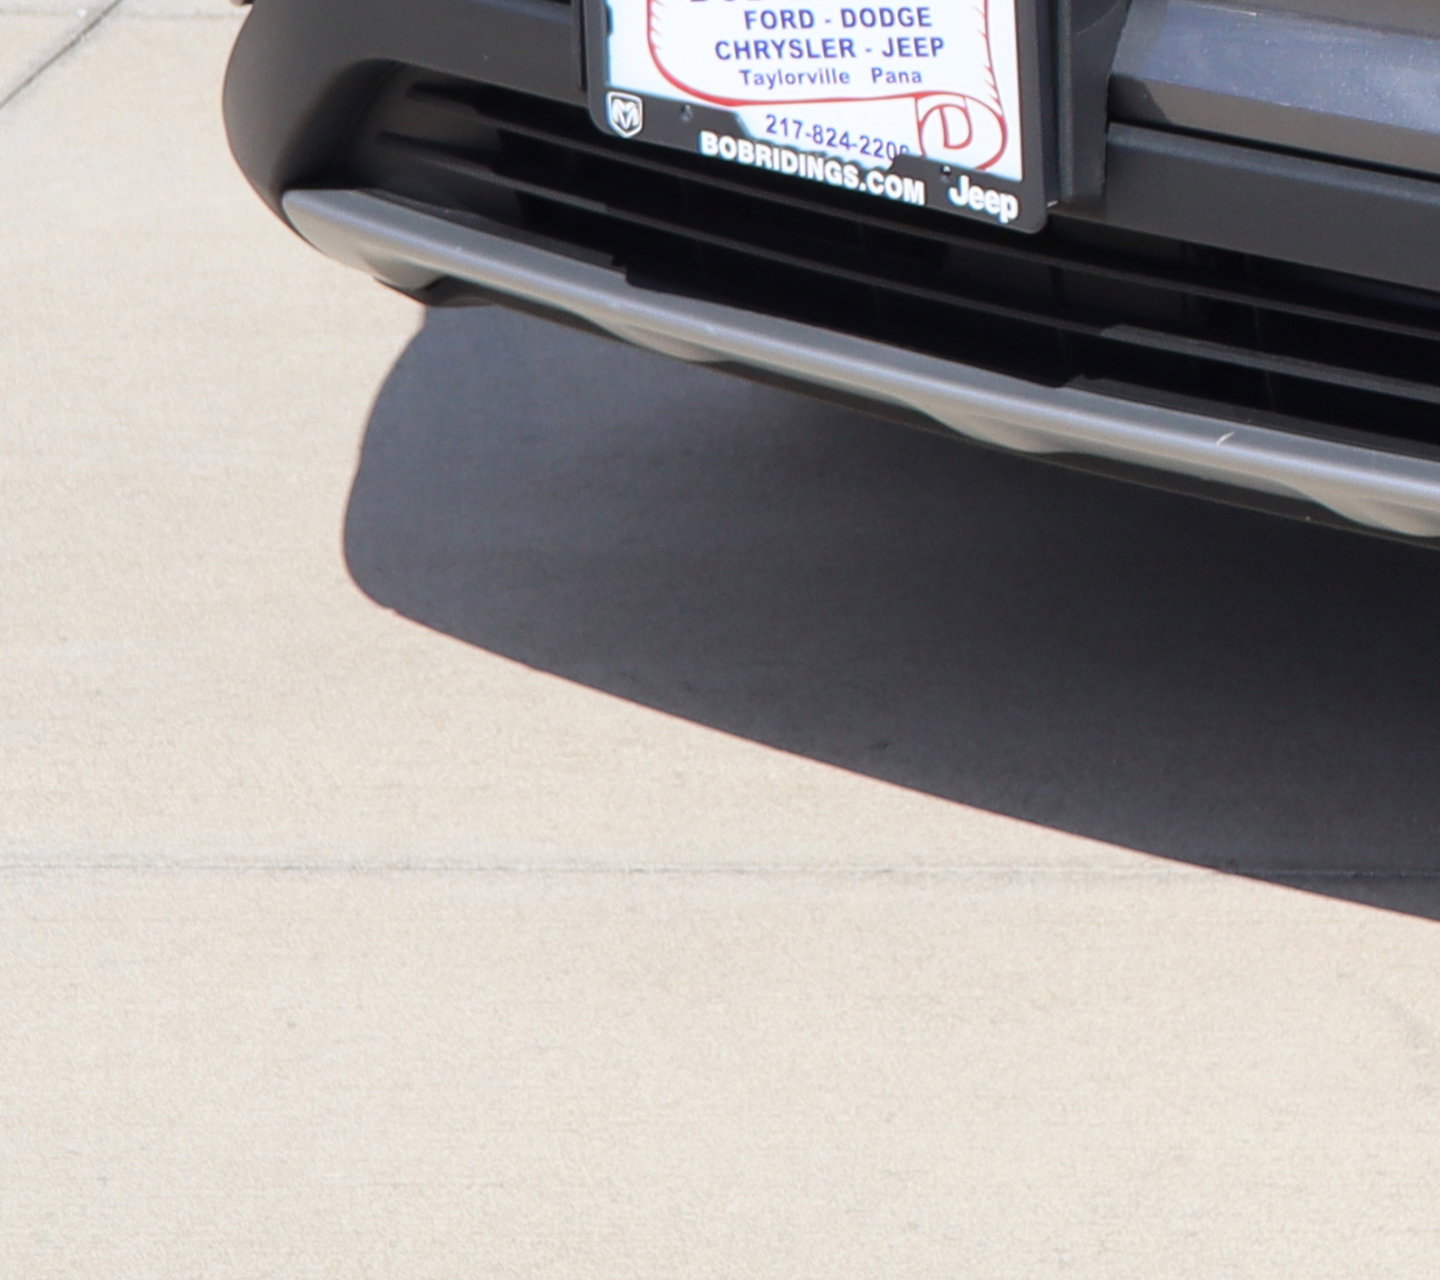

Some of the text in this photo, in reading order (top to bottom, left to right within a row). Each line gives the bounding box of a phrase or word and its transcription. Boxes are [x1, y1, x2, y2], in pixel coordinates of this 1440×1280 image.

[743, 8, 815, 30] FORD
[840, 6, 933, 28] DODGE
[714, 39, 856, 60] CHRYSLER
[882, 37, 945, 58] JEEP
[739, 67, 923, 90] Taylorville Pana
[698, 130, 926, 206] BOBRIDINGS.COM
[948, 175, 1018, 224] Jeep
